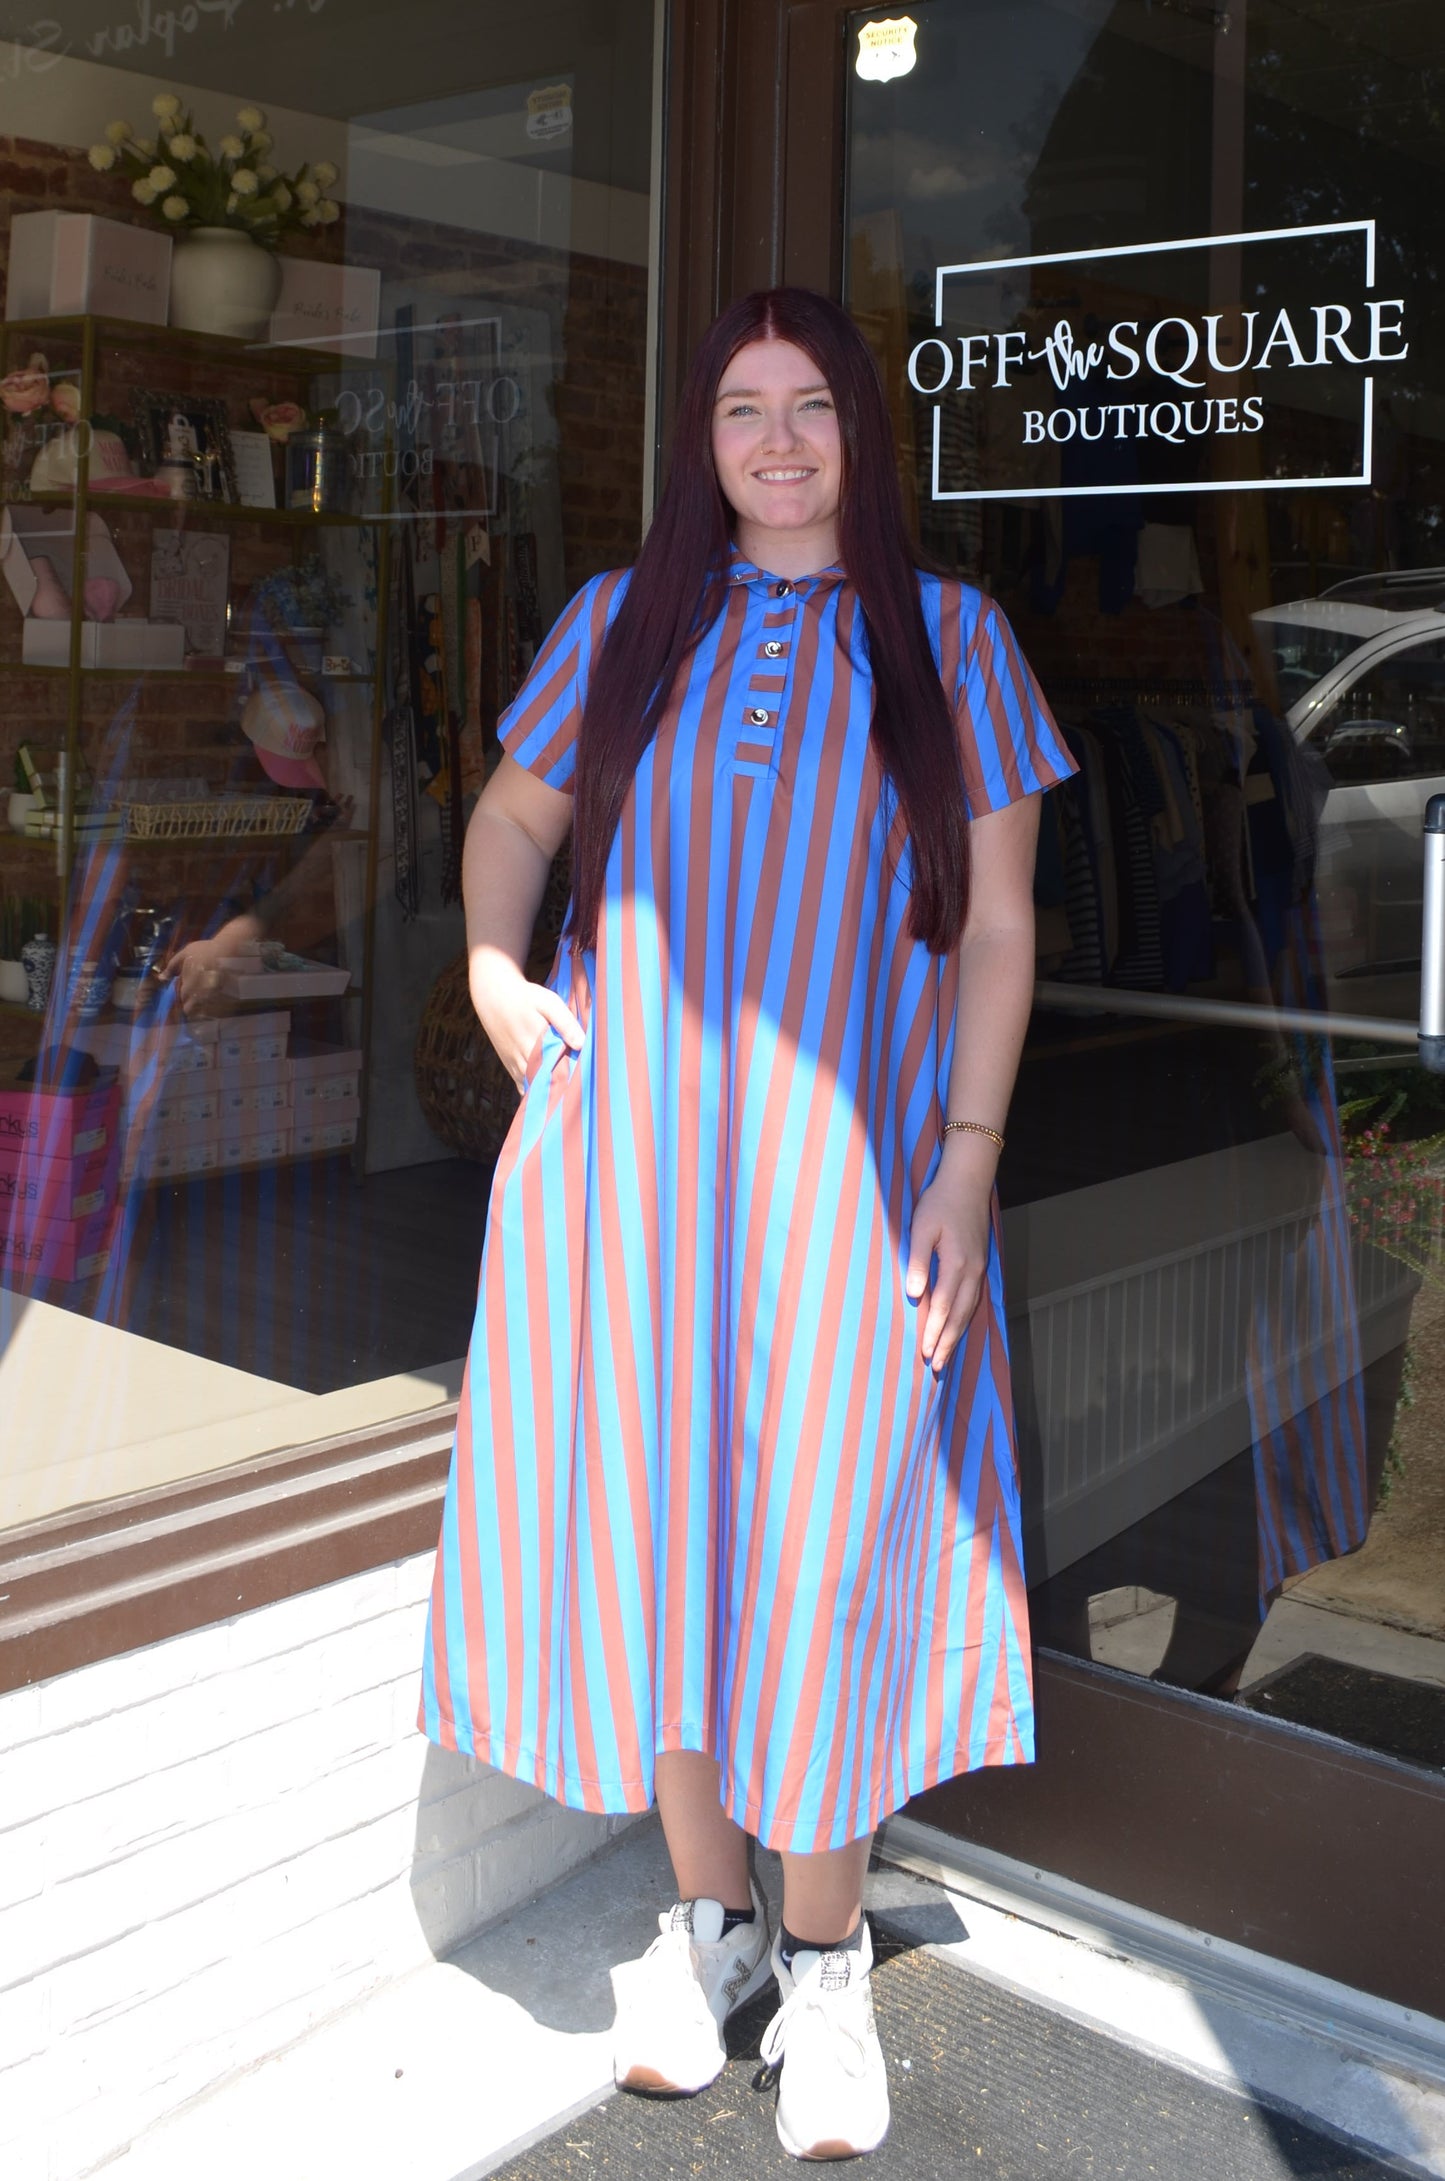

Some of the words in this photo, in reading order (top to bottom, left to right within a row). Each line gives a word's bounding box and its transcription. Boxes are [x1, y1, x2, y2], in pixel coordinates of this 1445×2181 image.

[865, 27, 907, 39] SECURITY
[907, 332, 1026, 394] OFF
[1028, 320, 1104, 390] the
[1106, 299, 1409, 388] SQUARE
[1022, 397, 1264, 443] BOUTIQUES
